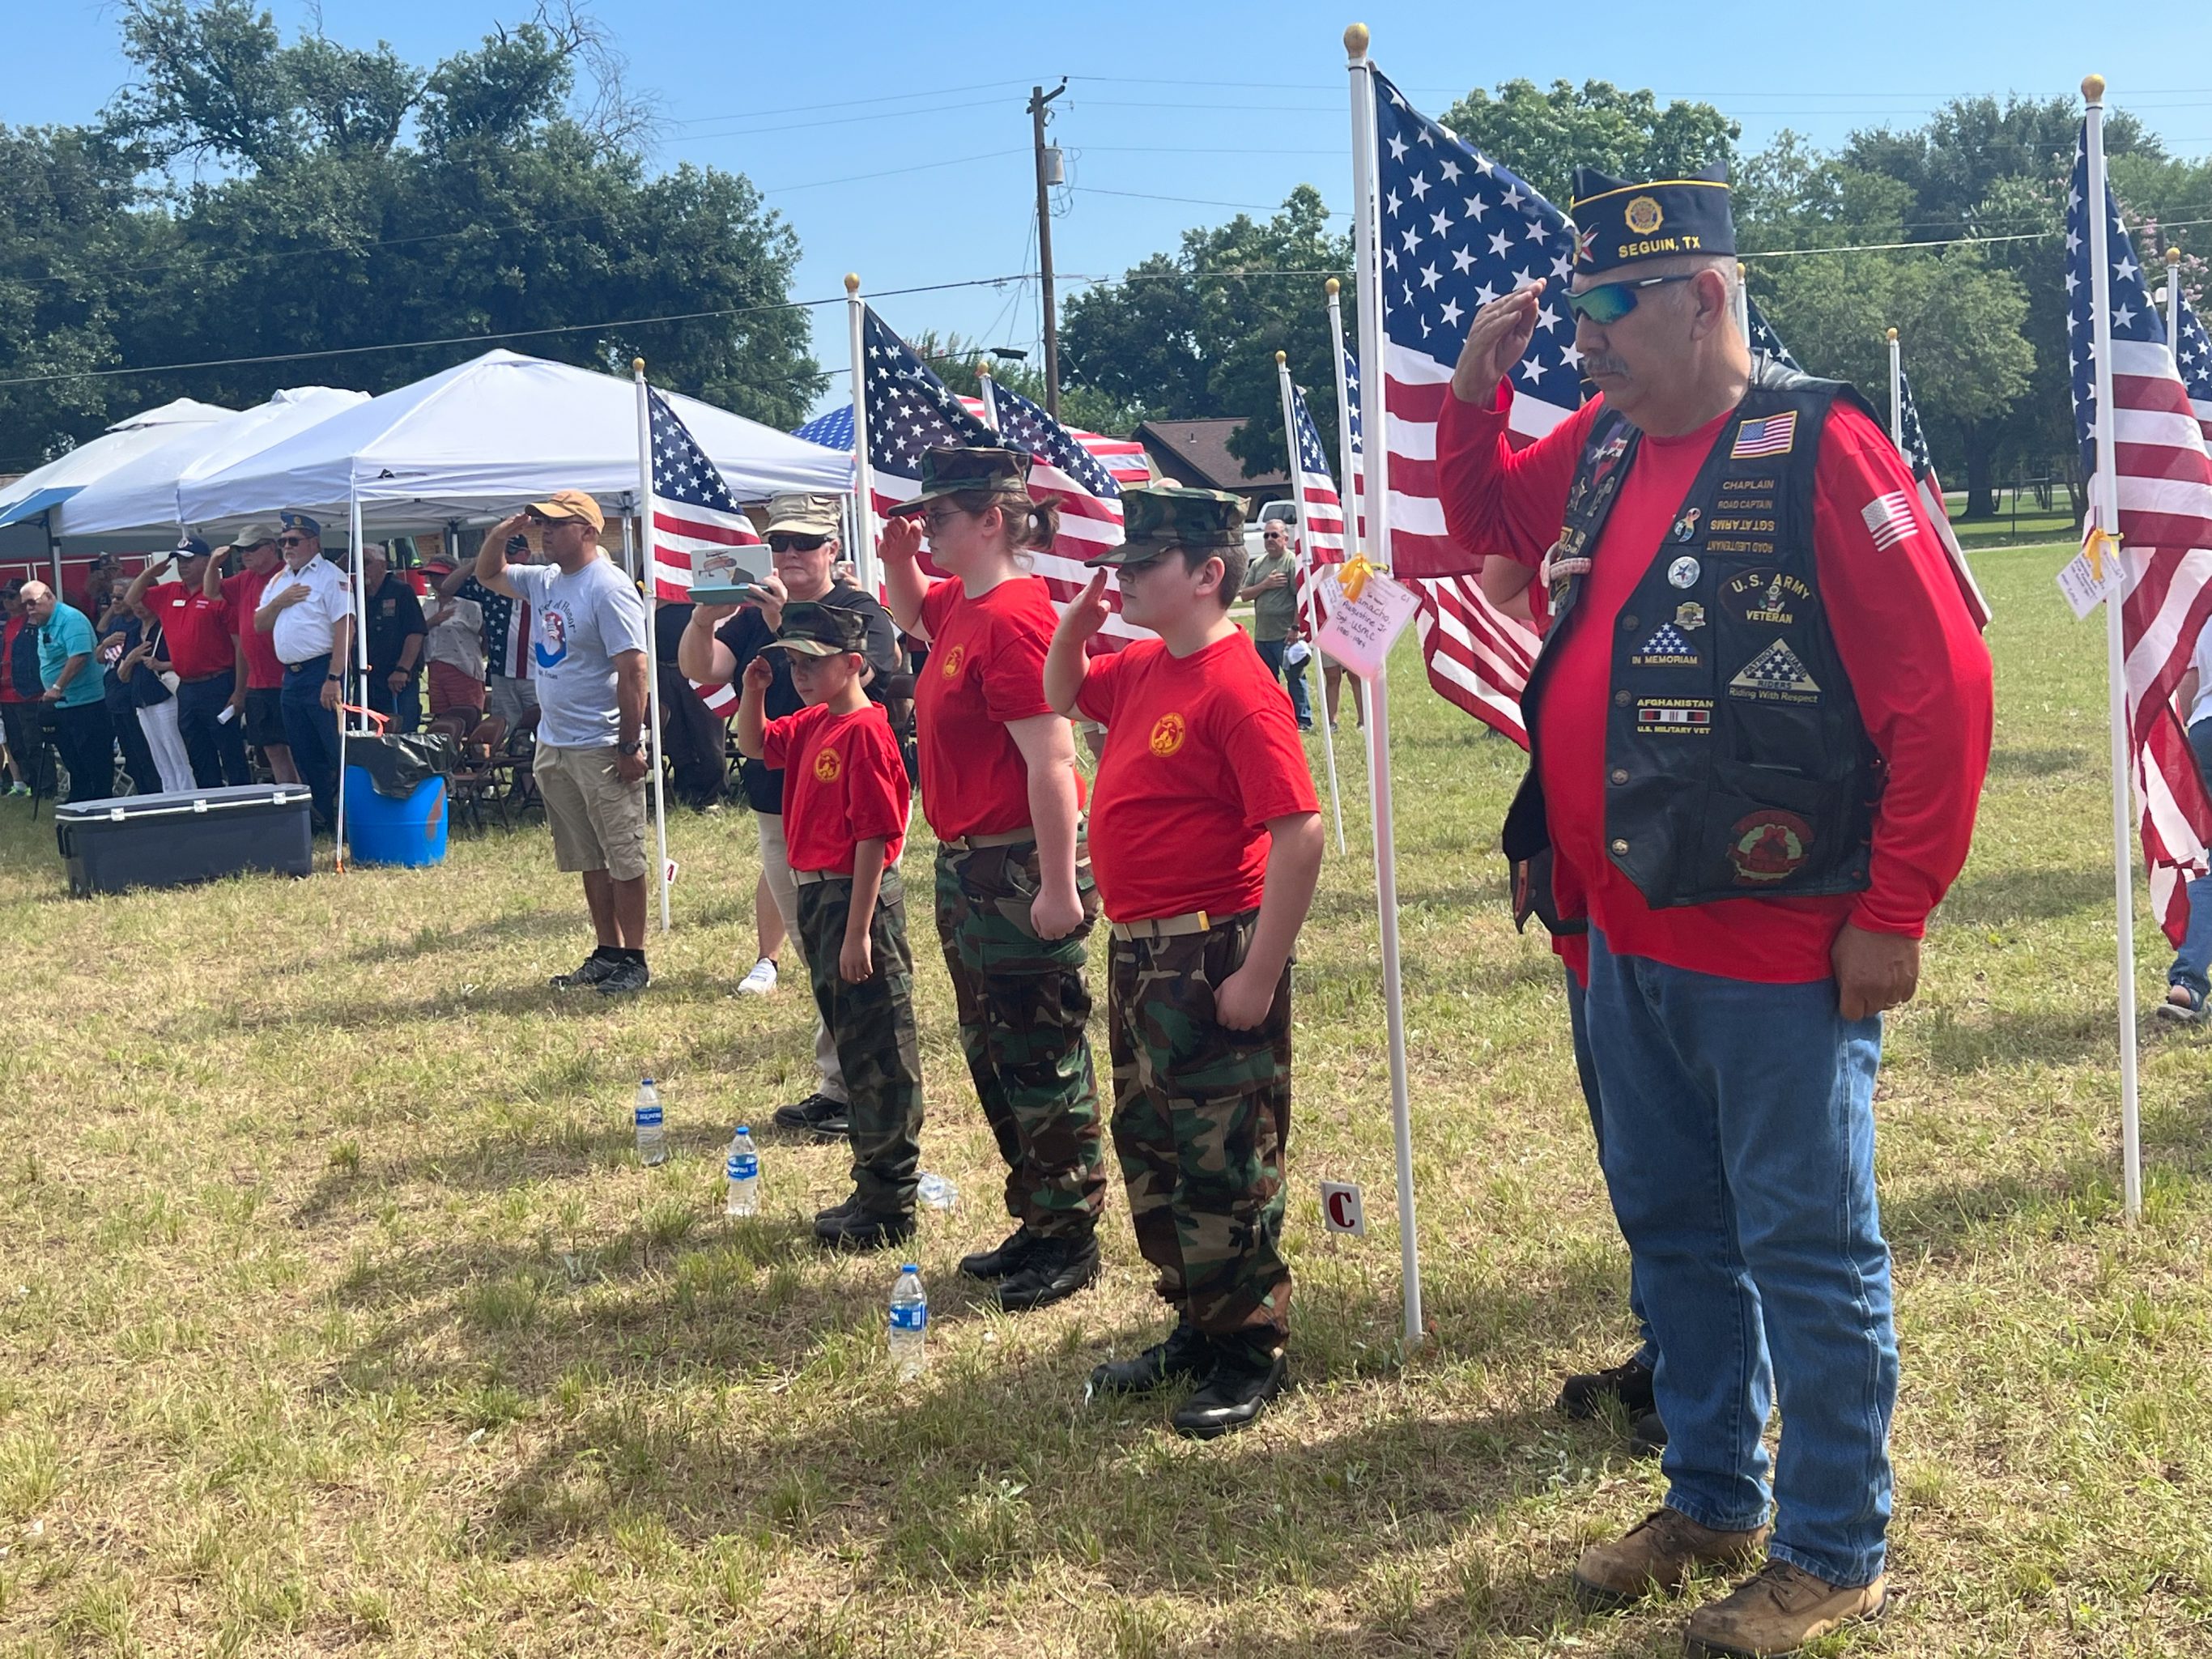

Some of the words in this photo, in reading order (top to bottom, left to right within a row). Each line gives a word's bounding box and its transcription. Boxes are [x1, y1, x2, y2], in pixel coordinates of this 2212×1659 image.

[1618, 238, 1679, 258] SEGUIN,
[1682, 236, 1701, 249] TX
[1722, 479, 1775, 491] CHAPLAIN
[1717, 500, 1739, 510] ROAD
[1739, 500, 1772, 510] CAPTAIN
[1710, 519, 1740, 530] ARMS
[1739, 520, 1752, 531] AT
[1752, 520, 1776, 531] SGT
[1752, 542, 1774, 554] ROAD
[1731, 573, 1763, 593] U.S.
[1772, 573, 1810, 600] ARMY
[1356, 598, 1391, 625] amacho,
[1746, 610, 1793, 623] VETERAN
[1631, 655, 1641, 665] IN
[1644, 654, 1698, 665] MEMORIAM
[1742, 645, 1776, 677] PATRIOT
[1783, 649, 1808, 678] GUARD
[1757, 680, 1792, 690] RIDERS
[1729, 687, 1756, 700] Riding
[1759, 688, 1780, 701] With
[1780, 691, 1819, 704] Respect
[1636, 698, 1714, 708] AFGHANISTAN
[1654, 725, 1692, 734] MILITARY
[1693, 726, 1711, 734] VET
[1328, 1191, 1355, 1228] C
